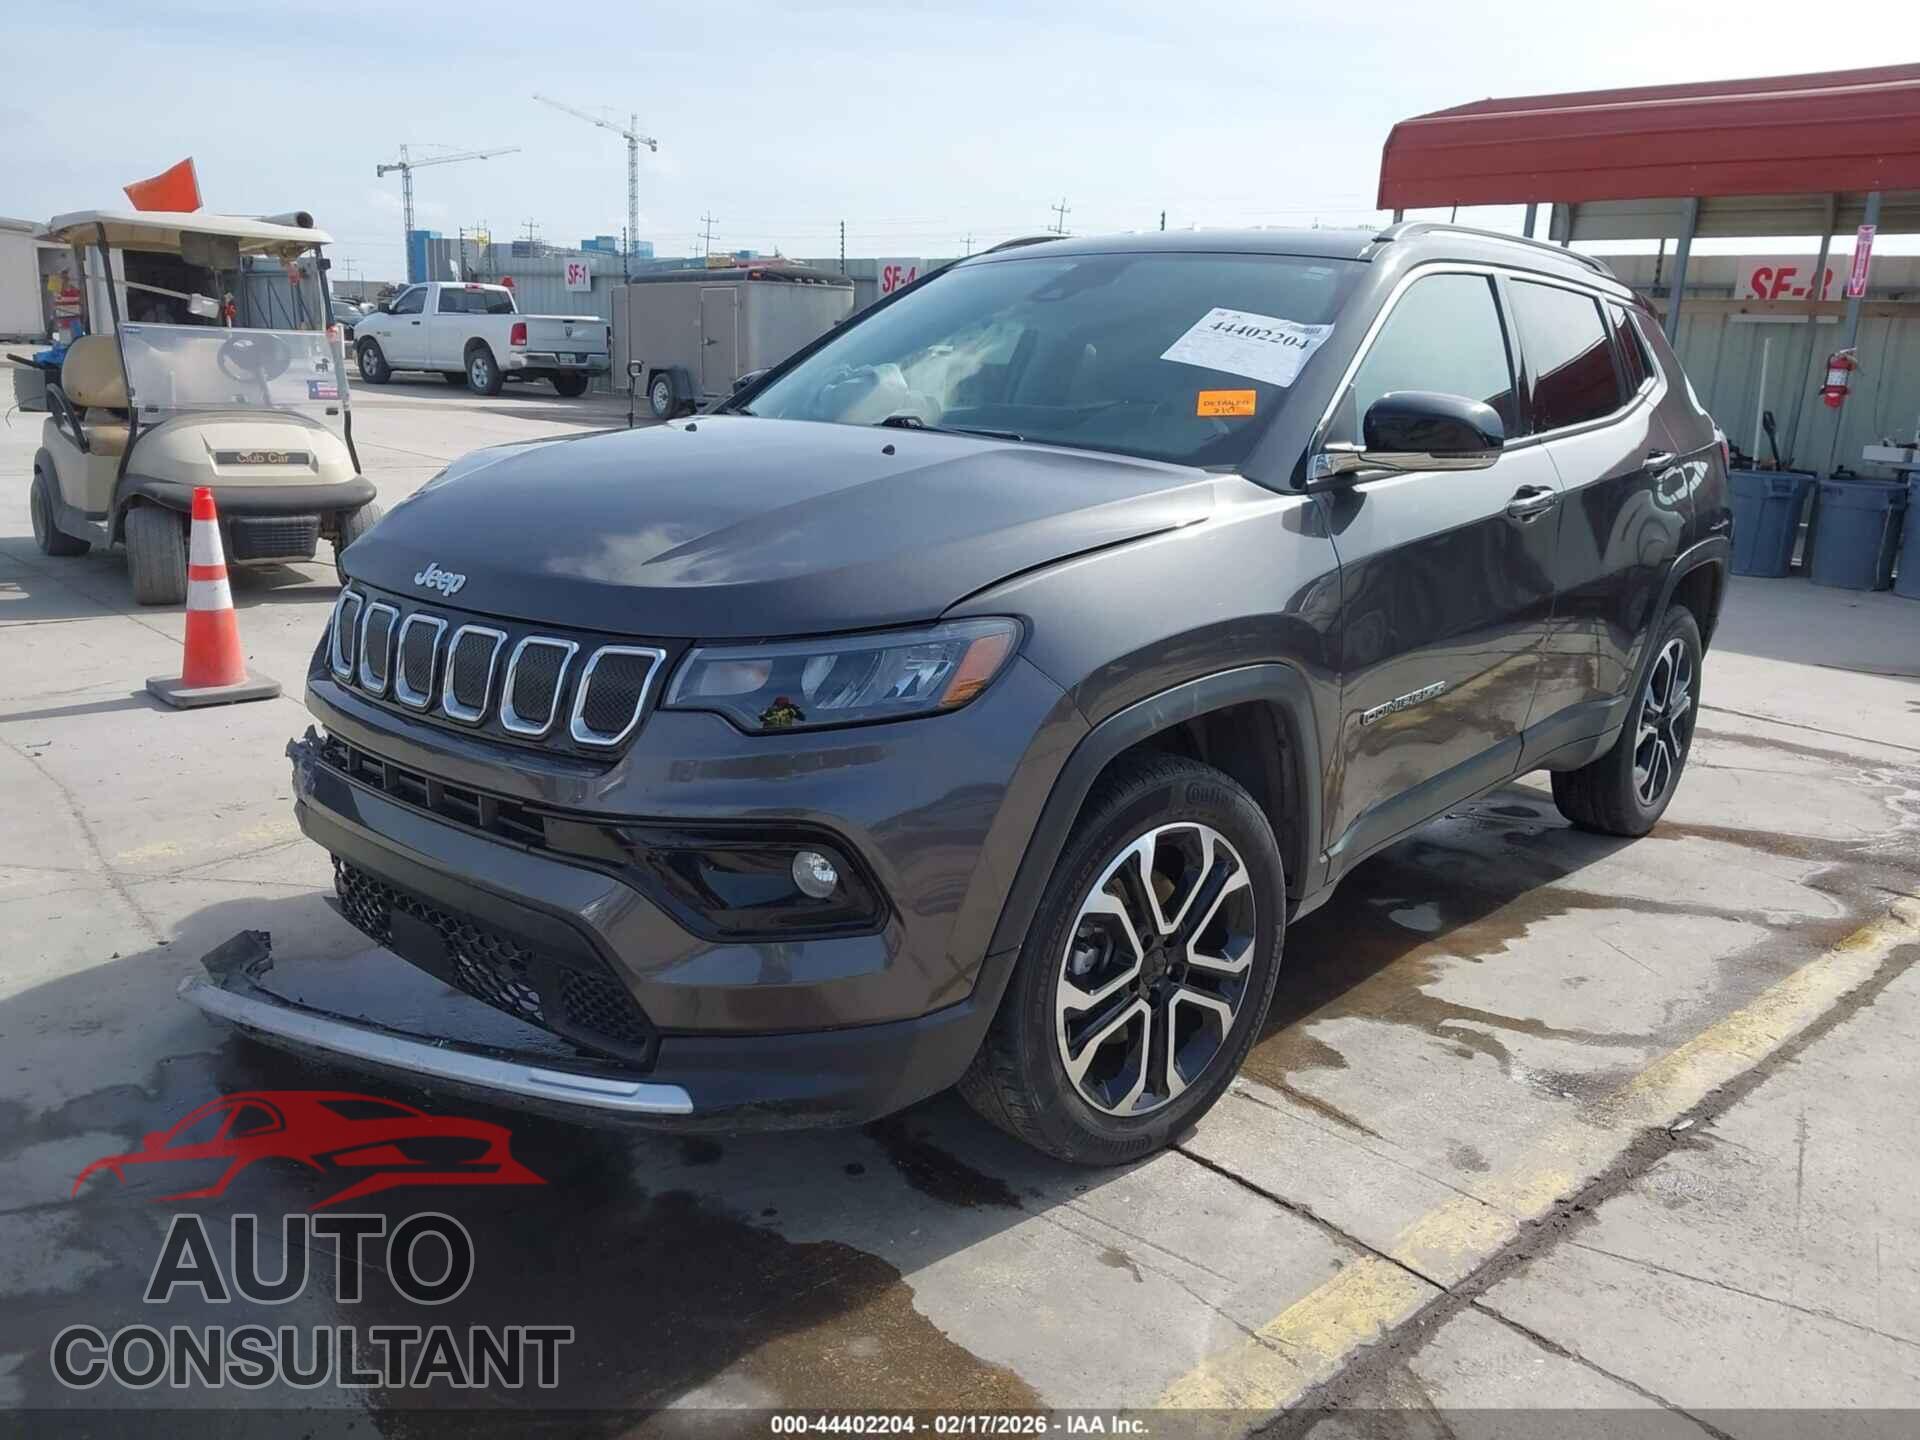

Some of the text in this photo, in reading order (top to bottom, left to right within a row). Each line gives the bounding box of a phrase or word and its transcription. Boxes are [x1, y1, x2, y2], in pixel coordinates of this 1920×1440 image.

[567, 264, 587, 285] SF-1
[1208, 320, 1308, 350] 44402204
[414, 562, 466, 597] Jeep
